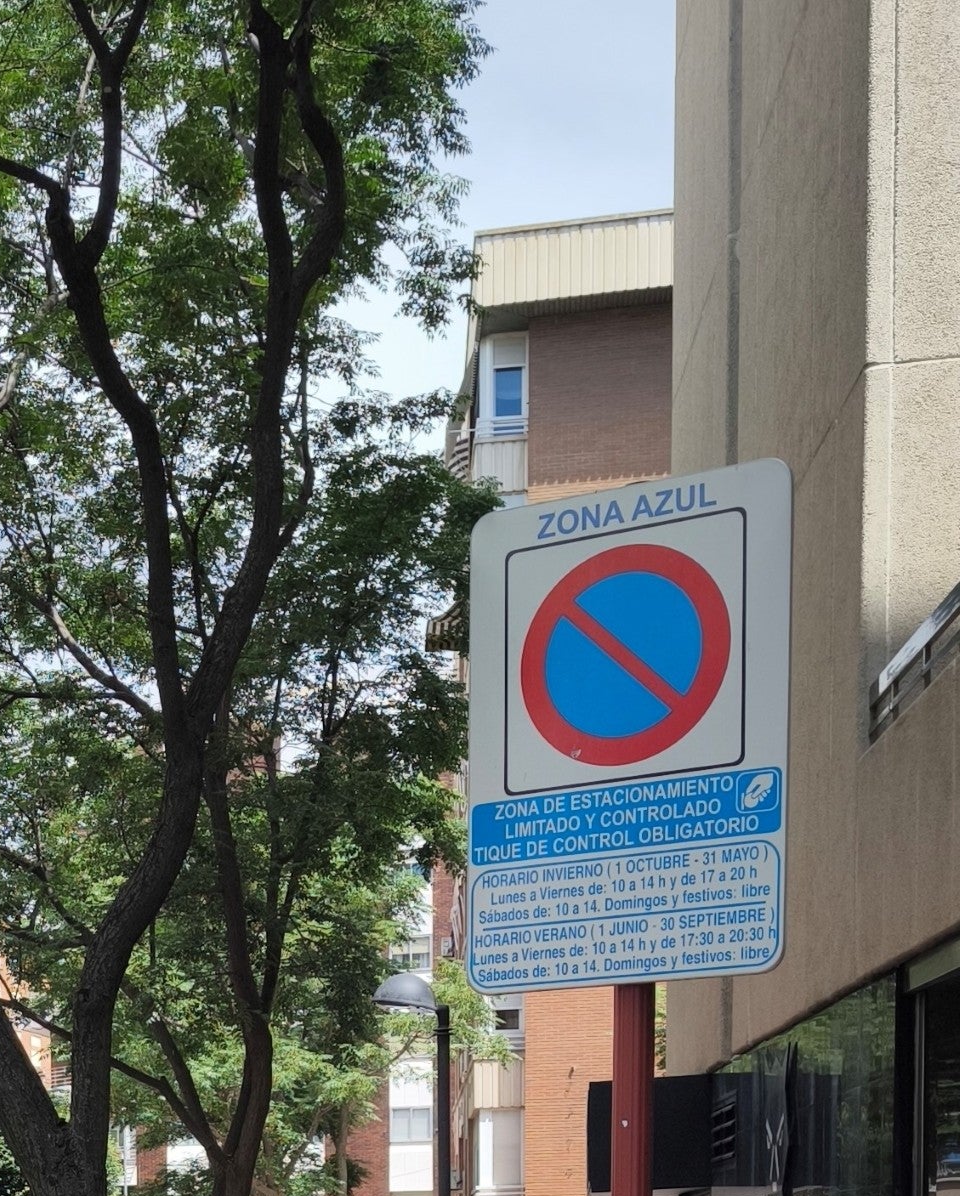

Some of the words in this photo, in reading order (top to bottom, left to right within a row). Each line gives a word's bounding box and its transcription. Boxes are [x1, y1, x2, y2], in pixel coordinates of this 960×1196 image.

[537, 500, 625, 540] ZONA
[631, 483, 717, 522] AZUL
[494, 801, 540, 820] ZONA
[543, 796, 565, 814] DE
[570, 775, 734, 811] ESTACIONAMIENTO
[474, 842, 521, 863] TIQUE
[526, 839, 548, 857] DE
[553, 829, 634, 854] CONTROL
[639, 815, 759, 844] OBLIGATORIO
[505, 815, 580, 839] LIMITADO
[585, 813, 596, 829] Y
[600, 798, 721, 828] CONTROLADO
[482, 870, 539, 889] HORARIO
[542, 863, 603, 882] INVIERNO
[626, 853, 690, 873] OCTUBRE
[702, 851, 716, 865] 31
[721, 846, 759, 863] MAYO
[491, 892, 526, 905] Lunes
[530, 891, 536, 901] a
[540, 886, 584, 901] Viernes
[588, 882, 607, 895] de:
[612, 879, 625, 892] 10
[629, 880, 636, 891] a
[641, 876, 654, 890] 14
[658, 875, 665, 888] h
[670, 877, 677, 890] y
[681, 872, 696, 885] de
[701, 870, 715, 883] 17
[719, 871, 726, 882] a
[730, 866, 745, 880] 20
[750, 865, 757, 878] h
[479, 909, 529, 924] Sábados
[533, 906, 551, 918] de:
[556, 903, 569, 916] 10
[572, 904, 579, 915] a
[584, 899, 600, 913] 14.
[605, 894, 667, 911] Domingos
[672, 894, 678, 908] y
[683, 888, 736, 903] festivos:
[742, 884, 770, 898] libre
[473, 953, 508, 966] Lunes
[512, 952, 518, 962] a
[521, 947, 566, 962] Viernes
[569, 944, 588, 956] de:
[593, 941, 606, 955] 10
[609, 943, 616, 953] a
[621, 939, 635, 952] 14
[639, 937, 646, 950] h
[650, 939, 657, 953] y
[661, 936, 676, 949] de
[681, 931, 713, 947] 17:30
[718, 933, 725, 943] a
[729, 927, 764, 942] 20:30
[768, 926, 776, 939] h
[475, 930, 531, 949] HORARIO
[534, 925, 587, 942] VERANO
[609, 919, 648, 936] JUNIO
[661, 917, 675, 931] 30
[679, 908, 766, 928] SEPTIEMBRE
[478, 969, 528, 983] Sábados
[533, 965, 550, 977] de:
[555, 962, 568, 975] 10
[572, 964, 578, 974] a
[584, 959, 600, 973] 14.
[604, 955, 667, 971] Domingos
[671, 955, 678, 969] y
[682, 950, 736, 964] festivos:
[741, 947, 770, 960] libre
